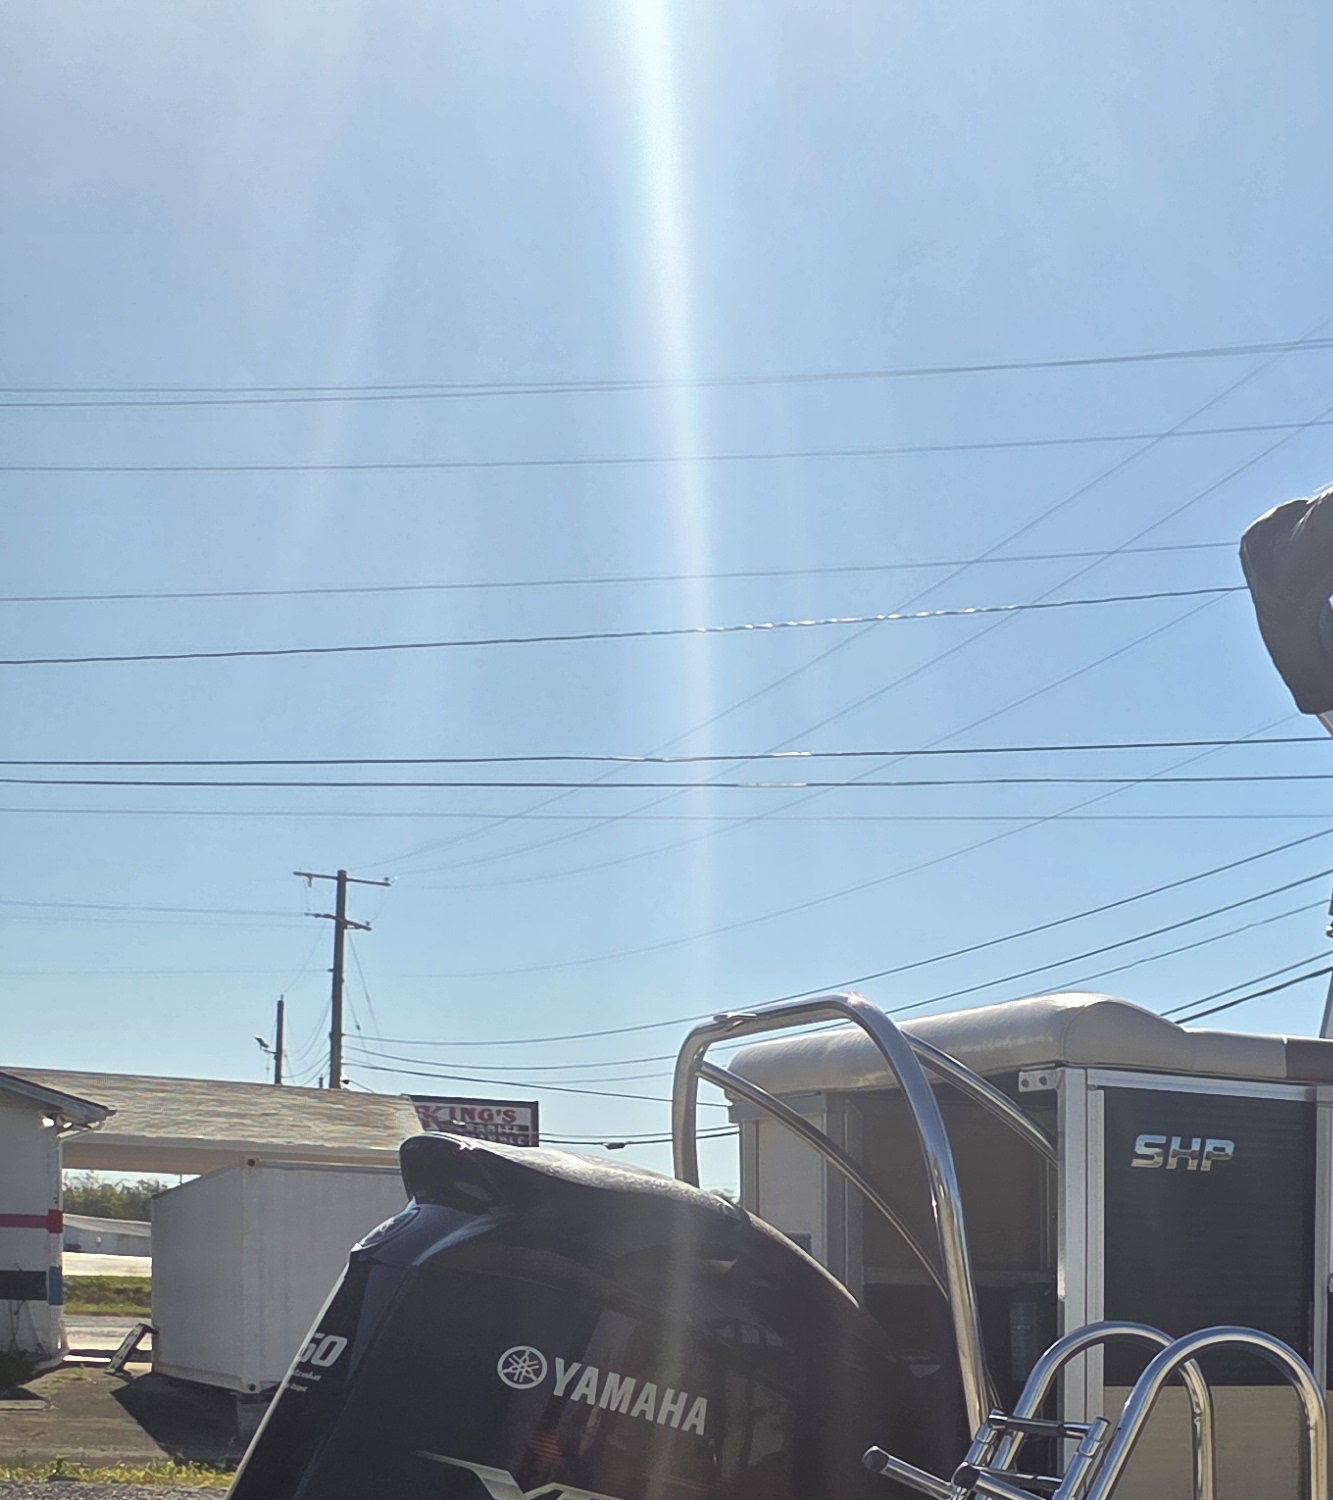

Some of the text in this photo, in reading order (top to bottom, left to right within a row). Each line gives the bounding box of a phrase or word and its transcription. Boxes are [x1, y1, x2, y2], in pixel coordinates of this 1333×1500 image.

[415, 1105, 517, 1131] KING'S
[1131, 1134, 1235, 1171] SHP
[553, 1357, 708, 1436] YAMAHA
